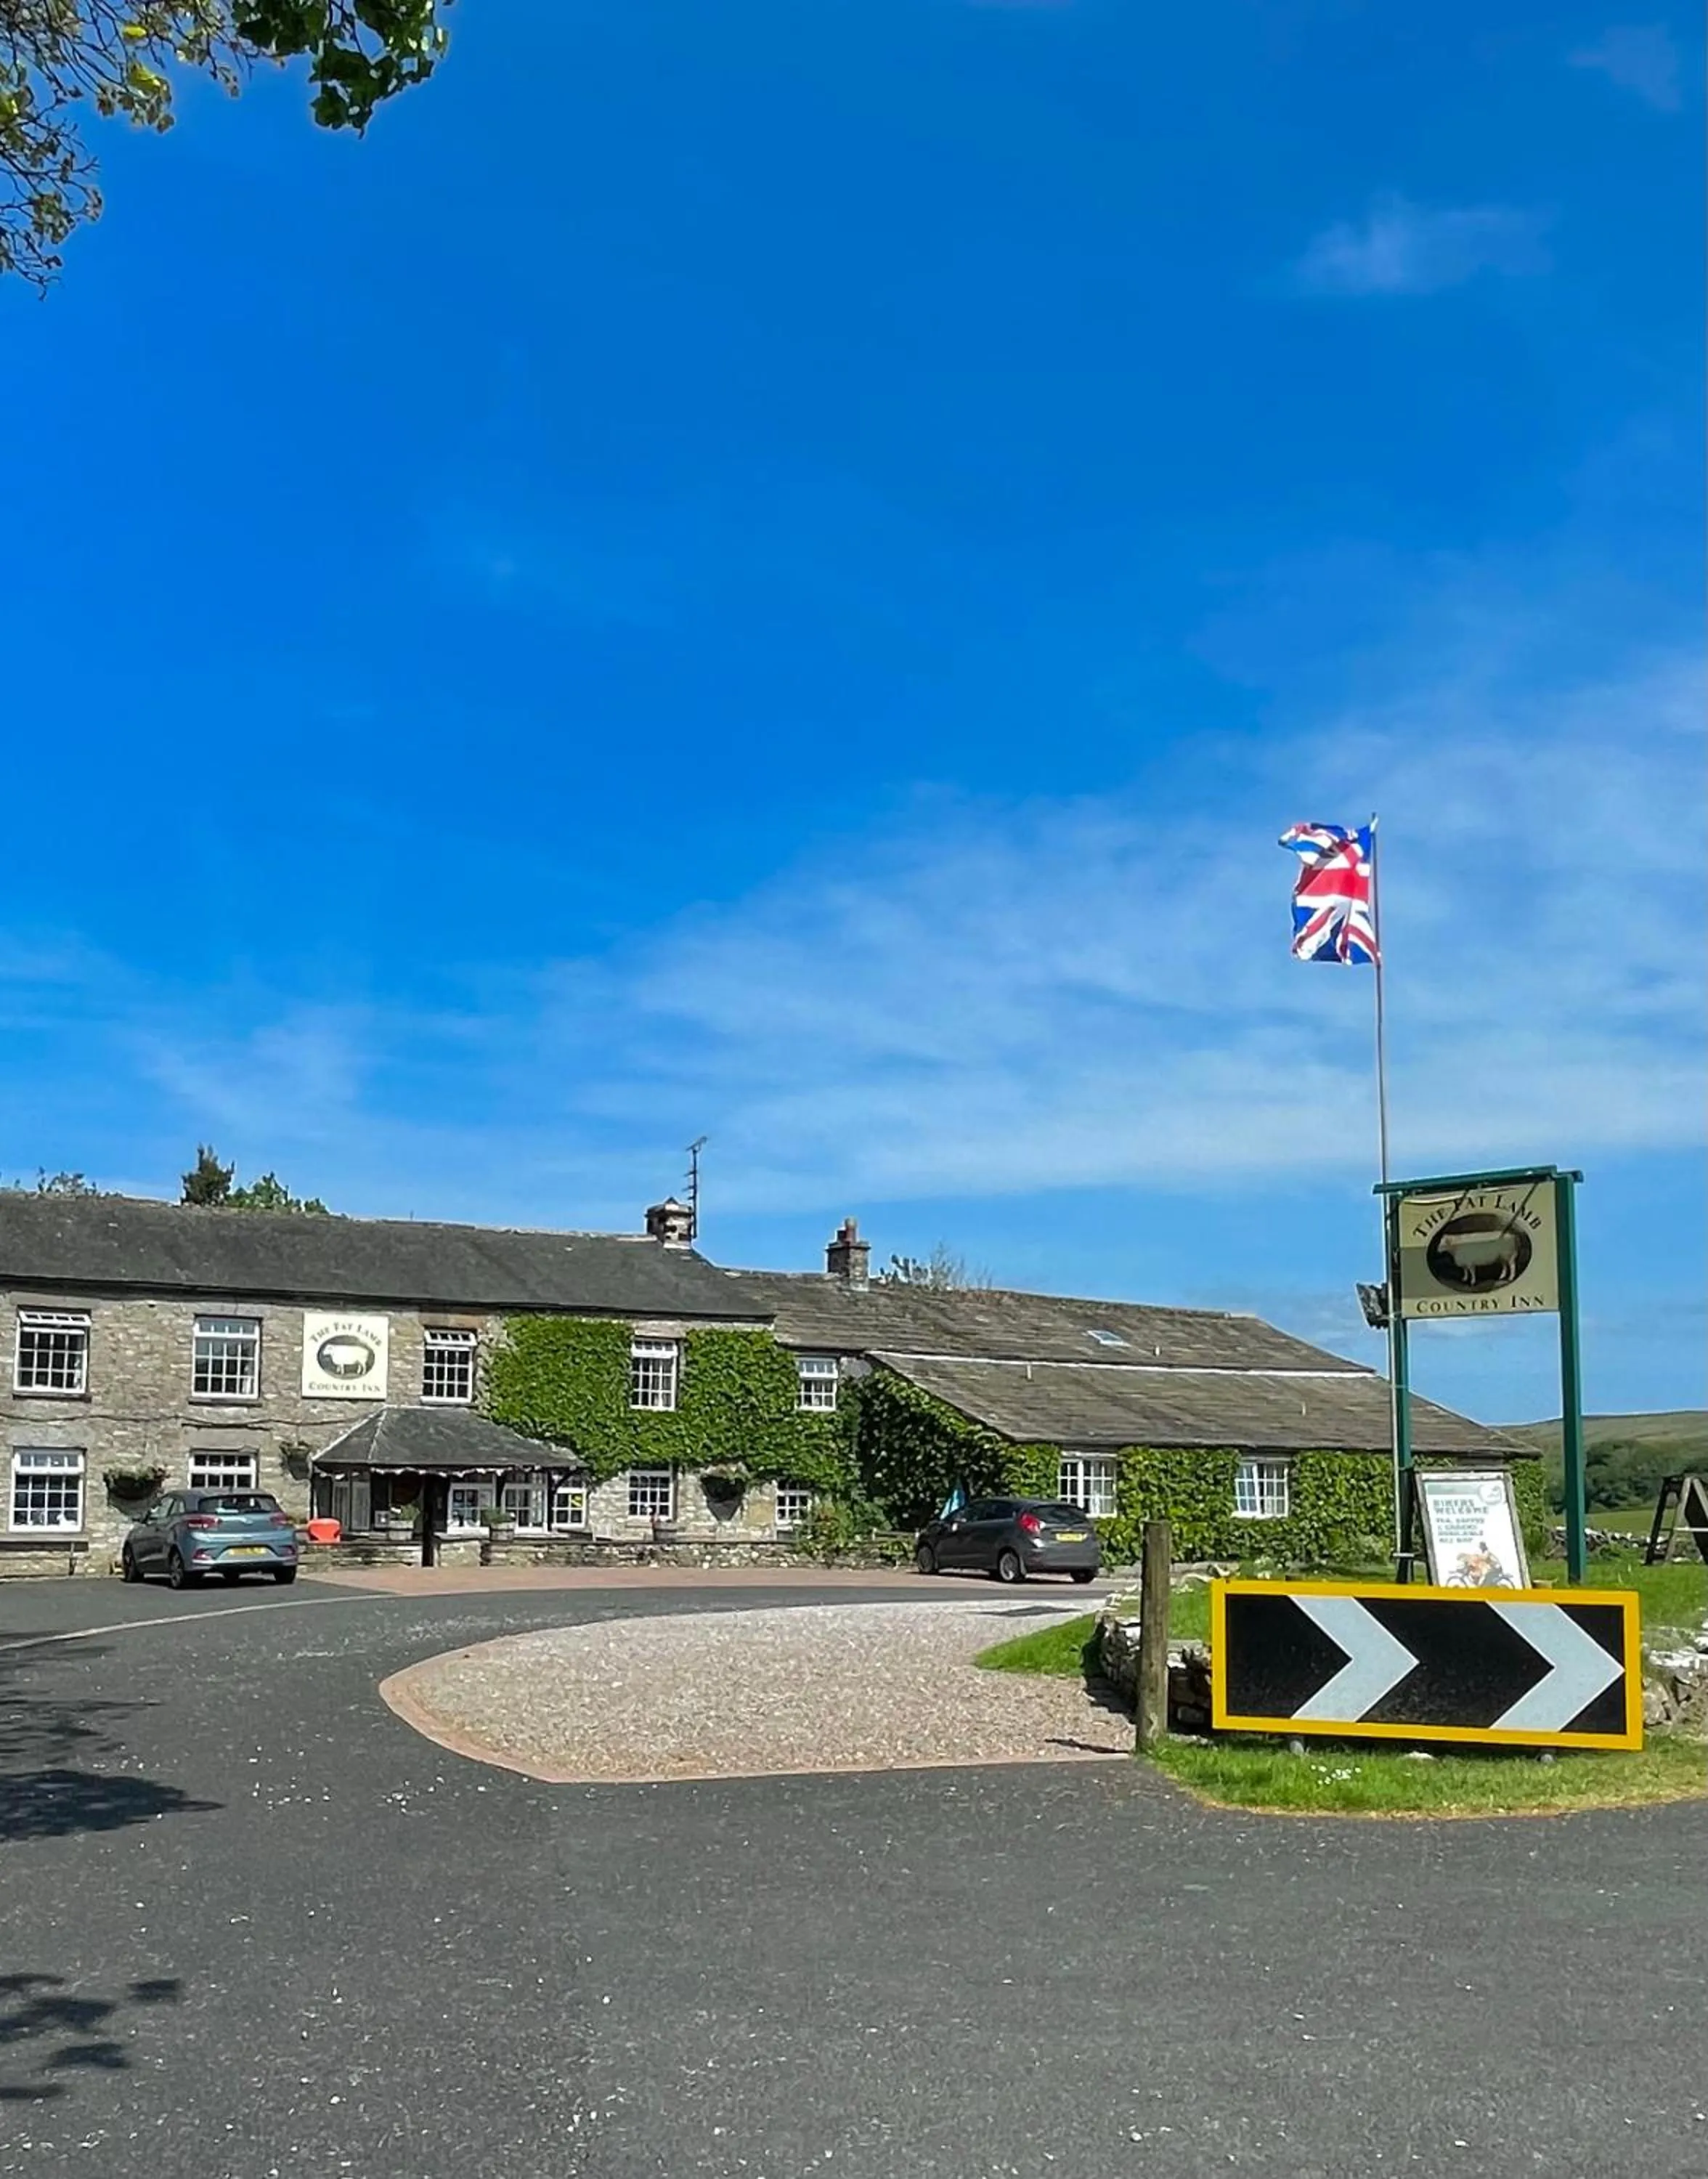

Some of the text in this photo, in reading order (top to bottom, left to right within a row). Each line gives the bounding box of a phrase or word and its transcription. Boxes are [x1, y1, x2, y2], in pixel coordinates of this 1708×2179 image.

[1412, 1195, 1542, 1237] THE FAT LAMB
[1416, 1294, 1545, 1314] COUNTRY INN
[310, 1322, 382, 1346] THE FAT LAMB
[309, 1381, 381, 1392] COUNTRY INN
